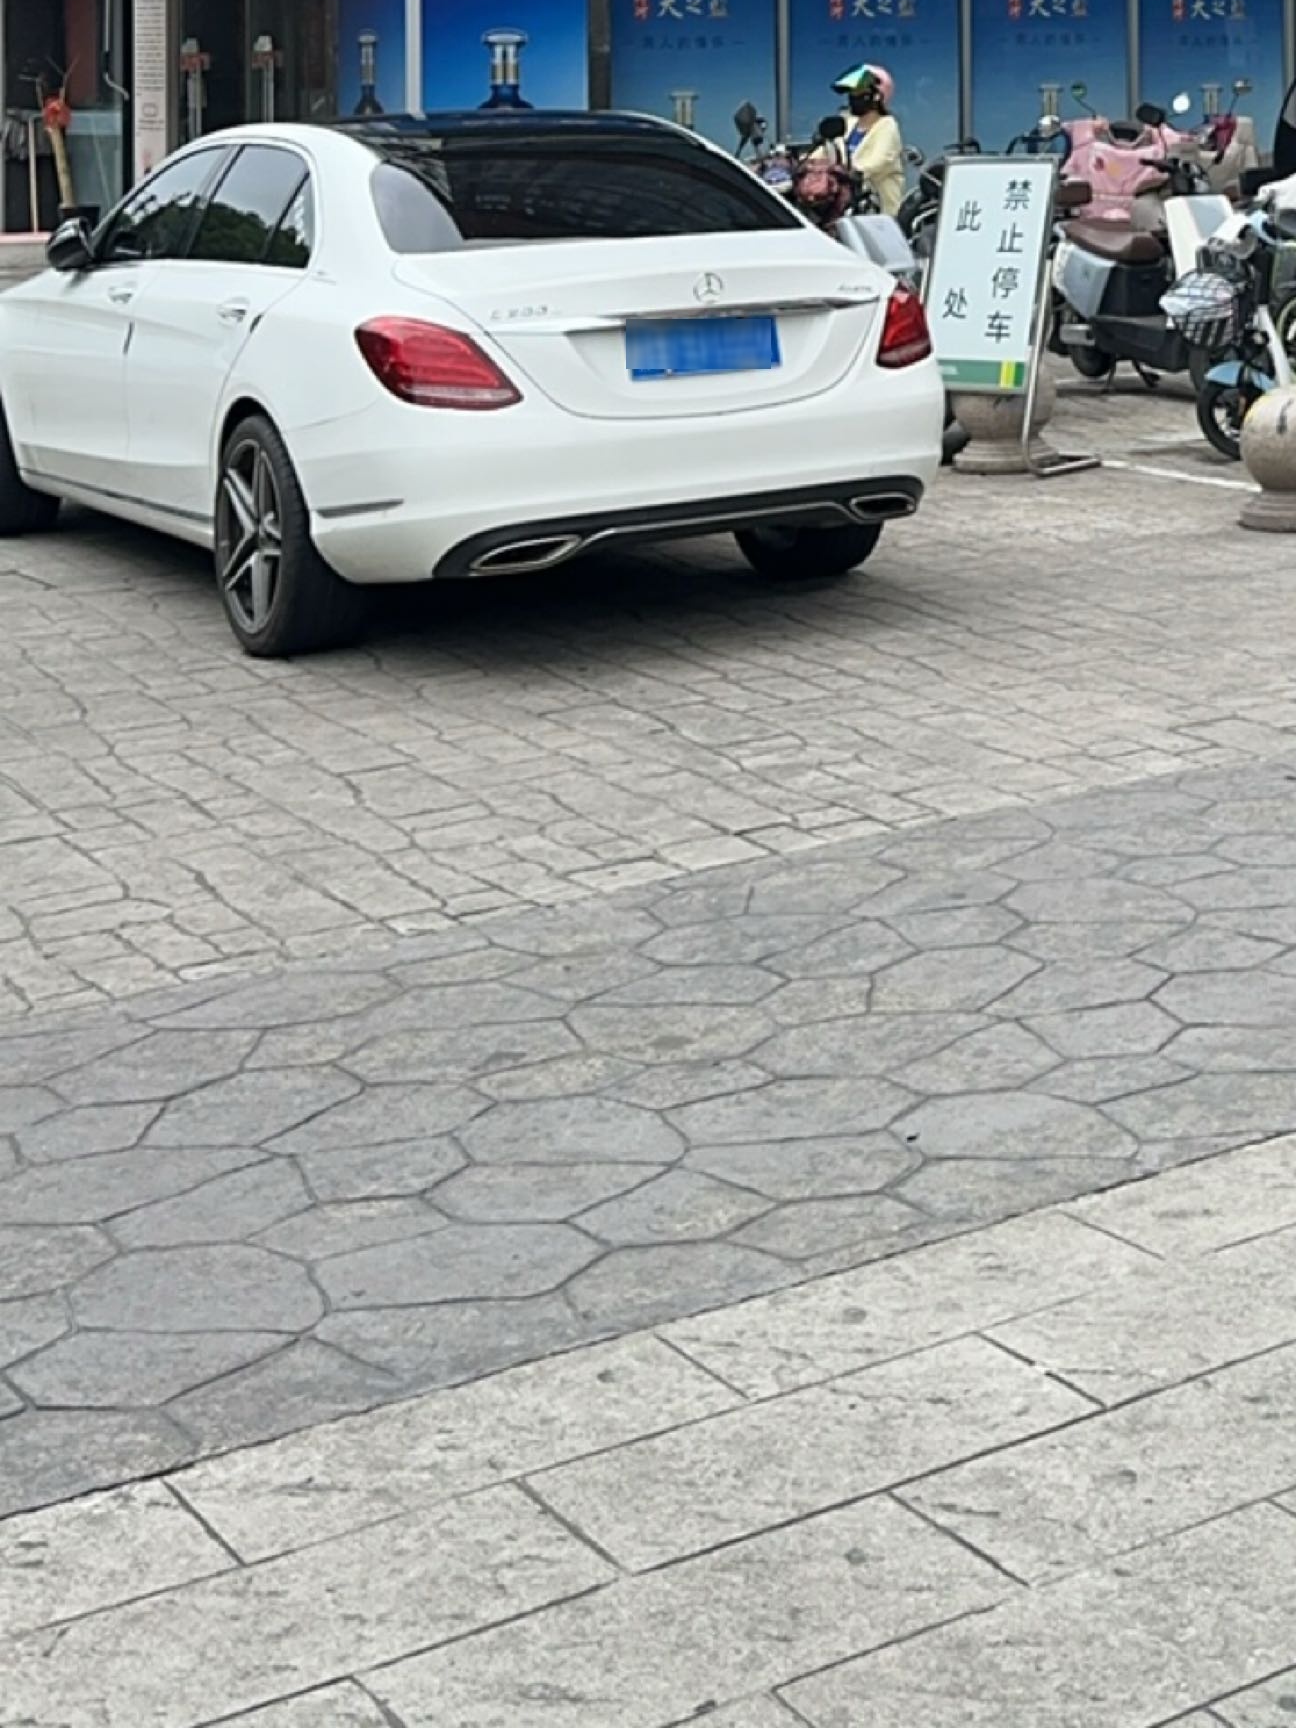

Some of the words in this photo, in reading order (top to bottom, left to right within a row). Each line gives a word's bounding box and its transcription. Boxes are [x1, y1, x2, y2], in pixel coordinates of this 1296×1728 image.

[943, 200, 982, 320] 此处
[984, 179, 1033, 344] 禁止停车
